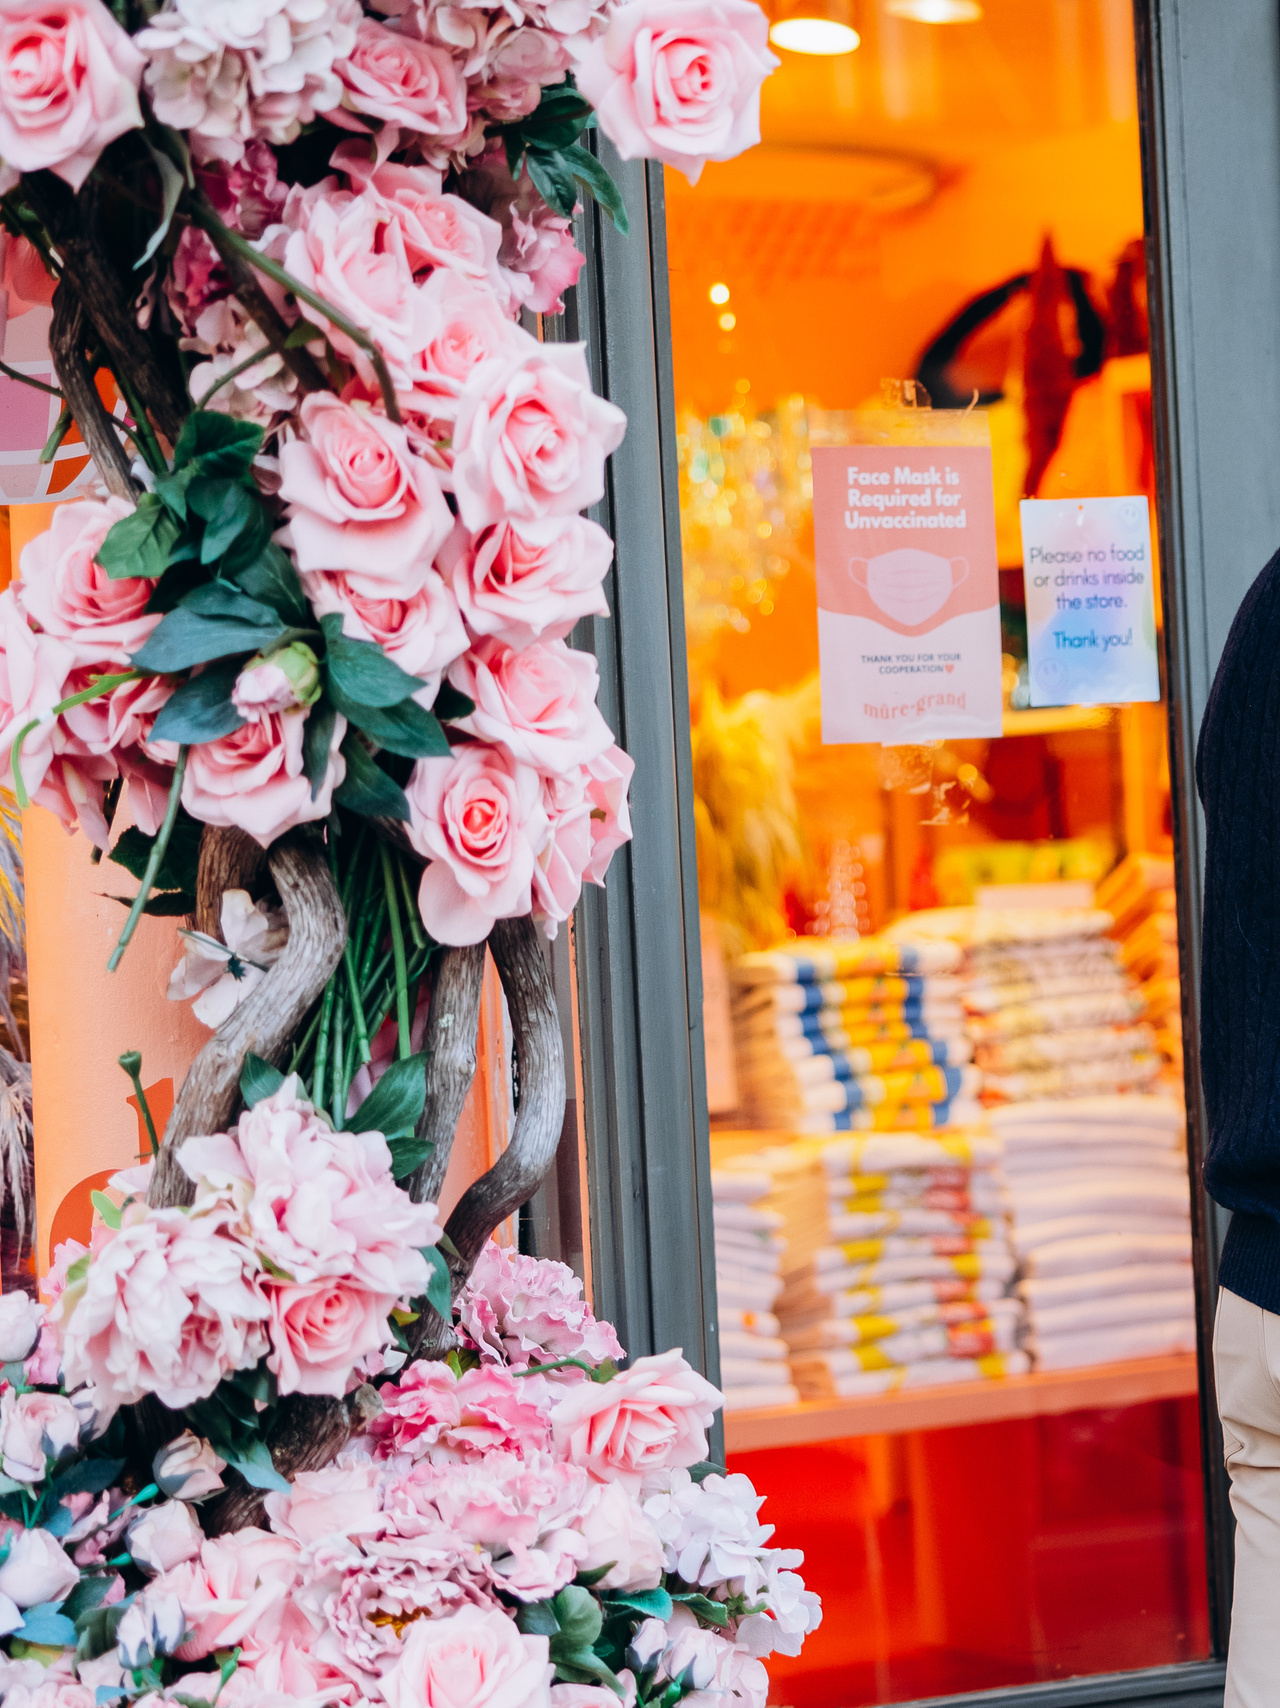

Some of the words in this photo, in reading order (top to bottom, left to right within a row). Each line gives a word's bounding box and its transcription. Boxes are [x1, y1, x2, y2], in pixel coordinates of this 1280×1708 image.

[847, 466, 891, 485] Face
[894, 466, 942, 485] Mask
[944, 466, 960, 485] is
[847, 488, 932, 512] Required
[935, 487, 962, 507] for
[844, 509, 966, 529] Unvaccinated
[1030, 546, 1083, 564] Please
[1087, 550, 1107, 562] no
[1110, 543, 1145, 561] food
[1034, 576, 1050, 587] or
[1054, 569, 1100, 587] drinks
[1102, 567, 1145, 585] inside
[1056, 592, 1082, 610] the
[1085, 594, 1128, 609] store.
[1052, 629, 1100, 649] Thank
[1101, 627, 1133, 653] you!
[861, 654, 893, 663] THANK
[895, 653, 915, 662] YOU
[917, 653, 935, 661] FOR
[937, 652, 961, 661] YOUR
[878, 664, 944, 674] COOPERATION
